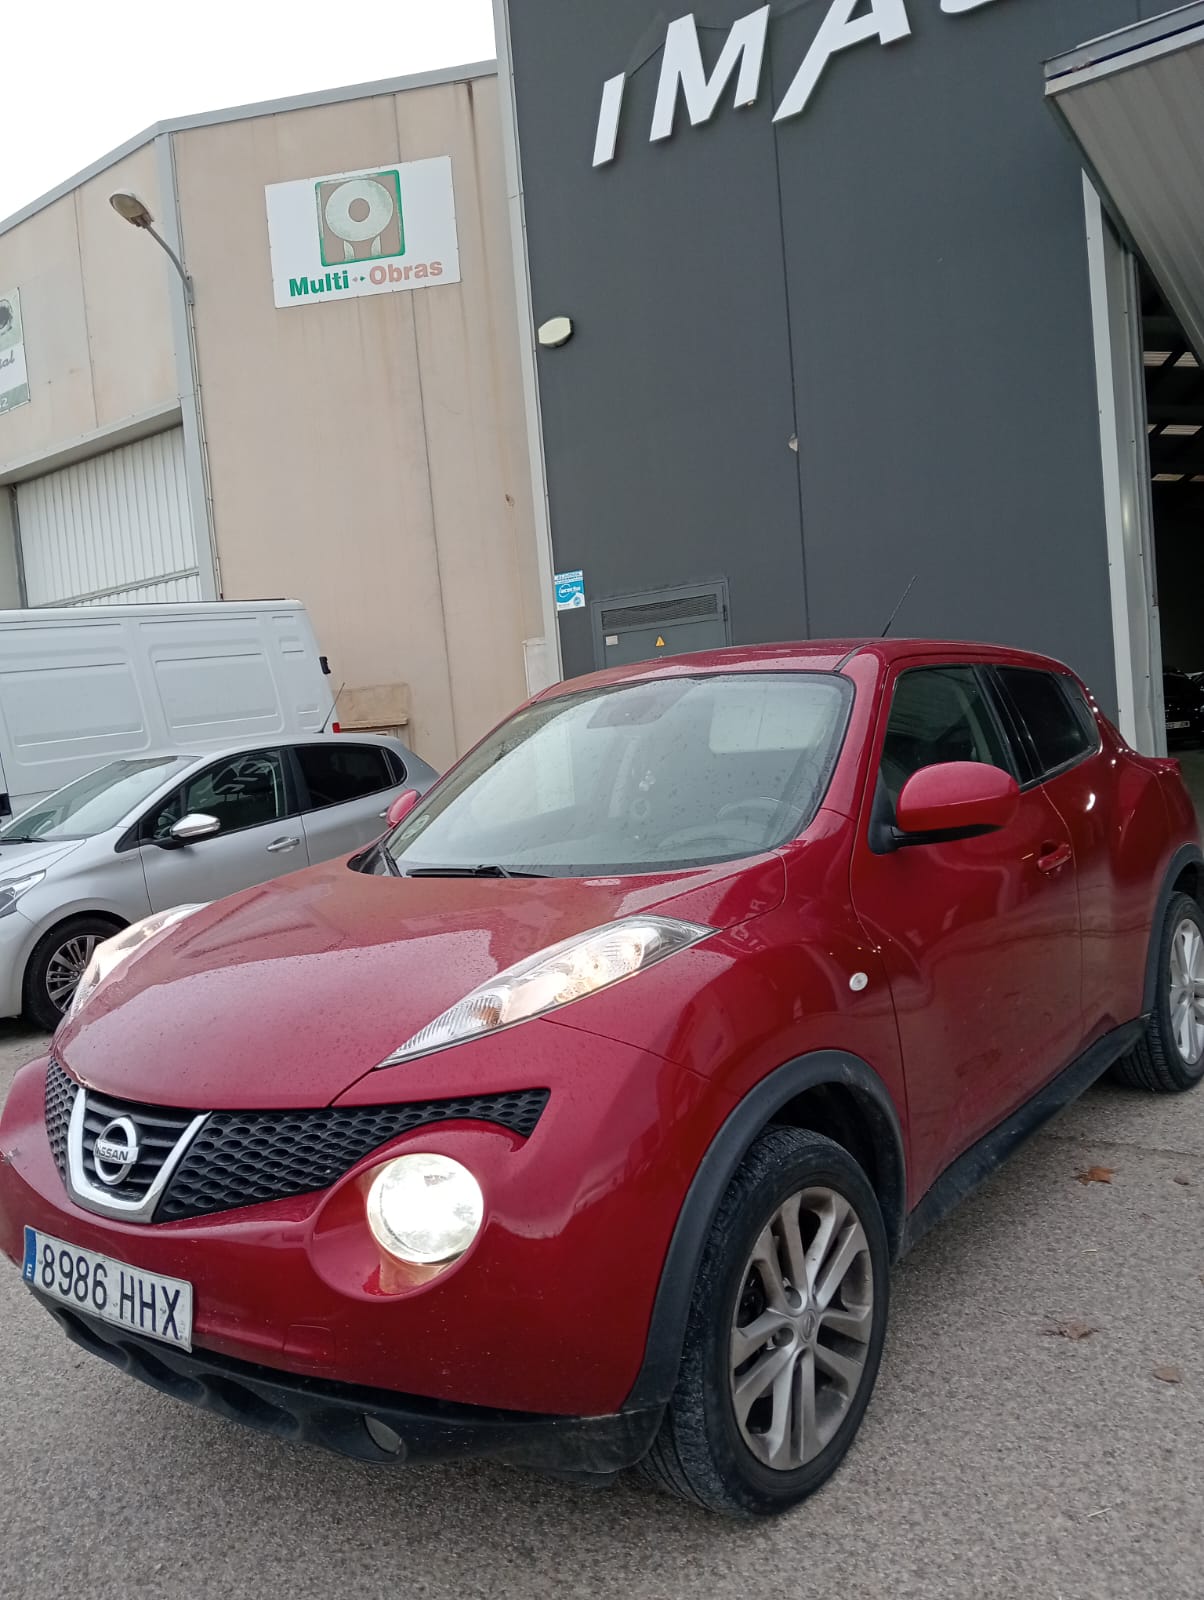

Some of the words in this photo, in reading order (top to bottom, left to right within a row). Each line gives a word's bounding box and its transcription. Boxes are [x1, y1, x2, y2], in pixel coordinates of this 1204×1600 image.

[592, 0, 1000, 167] IMA
[289, 270, 350, 297] Multi
[369, 261, 443, 285] Obras
[0, 348, 15, 370] al
[94, 1142, 129, 1161] NISSAN
[26, 1263, 33, 1277] E
[42, 1243, 108, 1311] 8986
[119, 1270, 181, 1341] HHX
